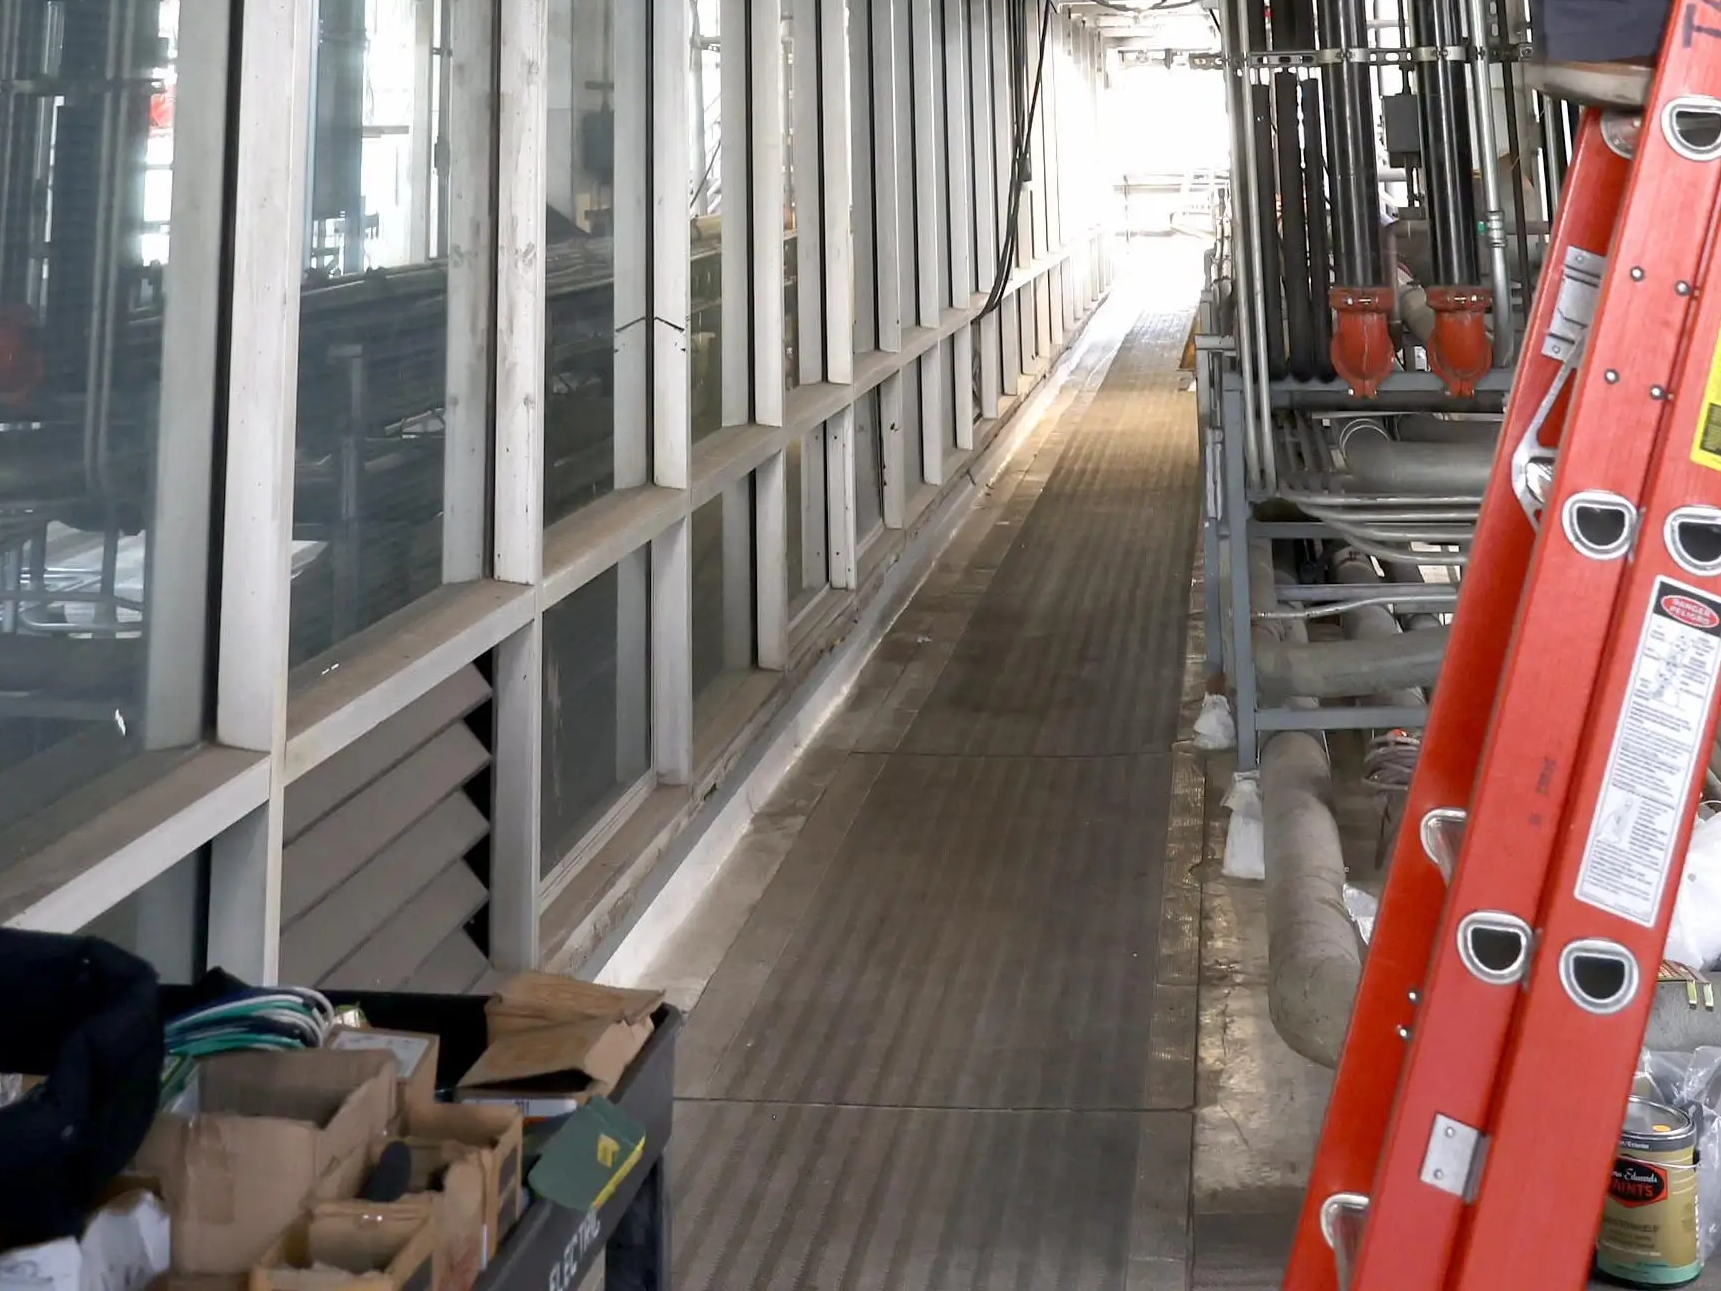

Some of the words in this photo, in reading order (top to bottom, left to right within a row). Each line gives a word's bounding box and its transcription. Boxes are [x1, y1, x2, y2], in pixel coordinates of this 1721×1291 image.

[1668, 605, 1711, 627] PELIGRO
[1671, 597, 1711, 618] DANGER
[1624, 1167, 1658, 1184] Edwards
[1612, 1179, 1655, 1197] AINTS
